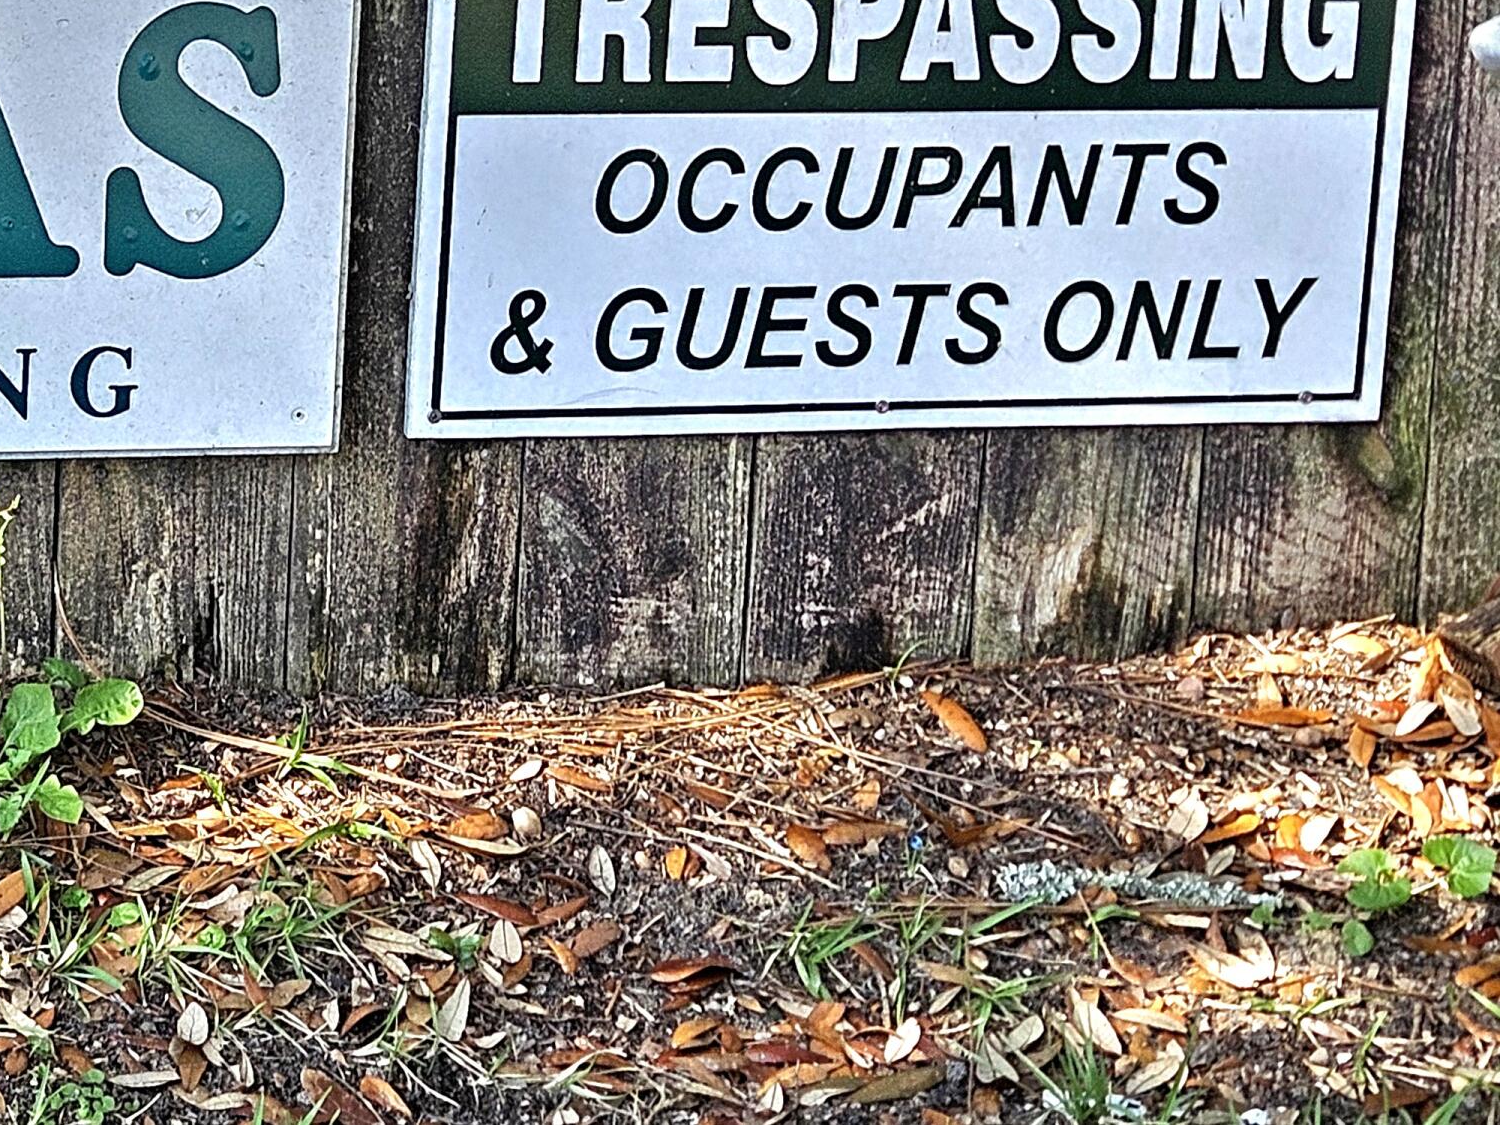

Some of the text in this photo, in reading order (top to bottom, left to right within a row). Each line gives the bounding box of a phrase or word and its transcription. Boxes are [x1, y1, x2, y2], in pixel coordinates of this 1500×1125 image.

[596, 142, 1227, 234] OCCUPANTS
[491, 278, 1318, 374] & GUESTS ONLY
